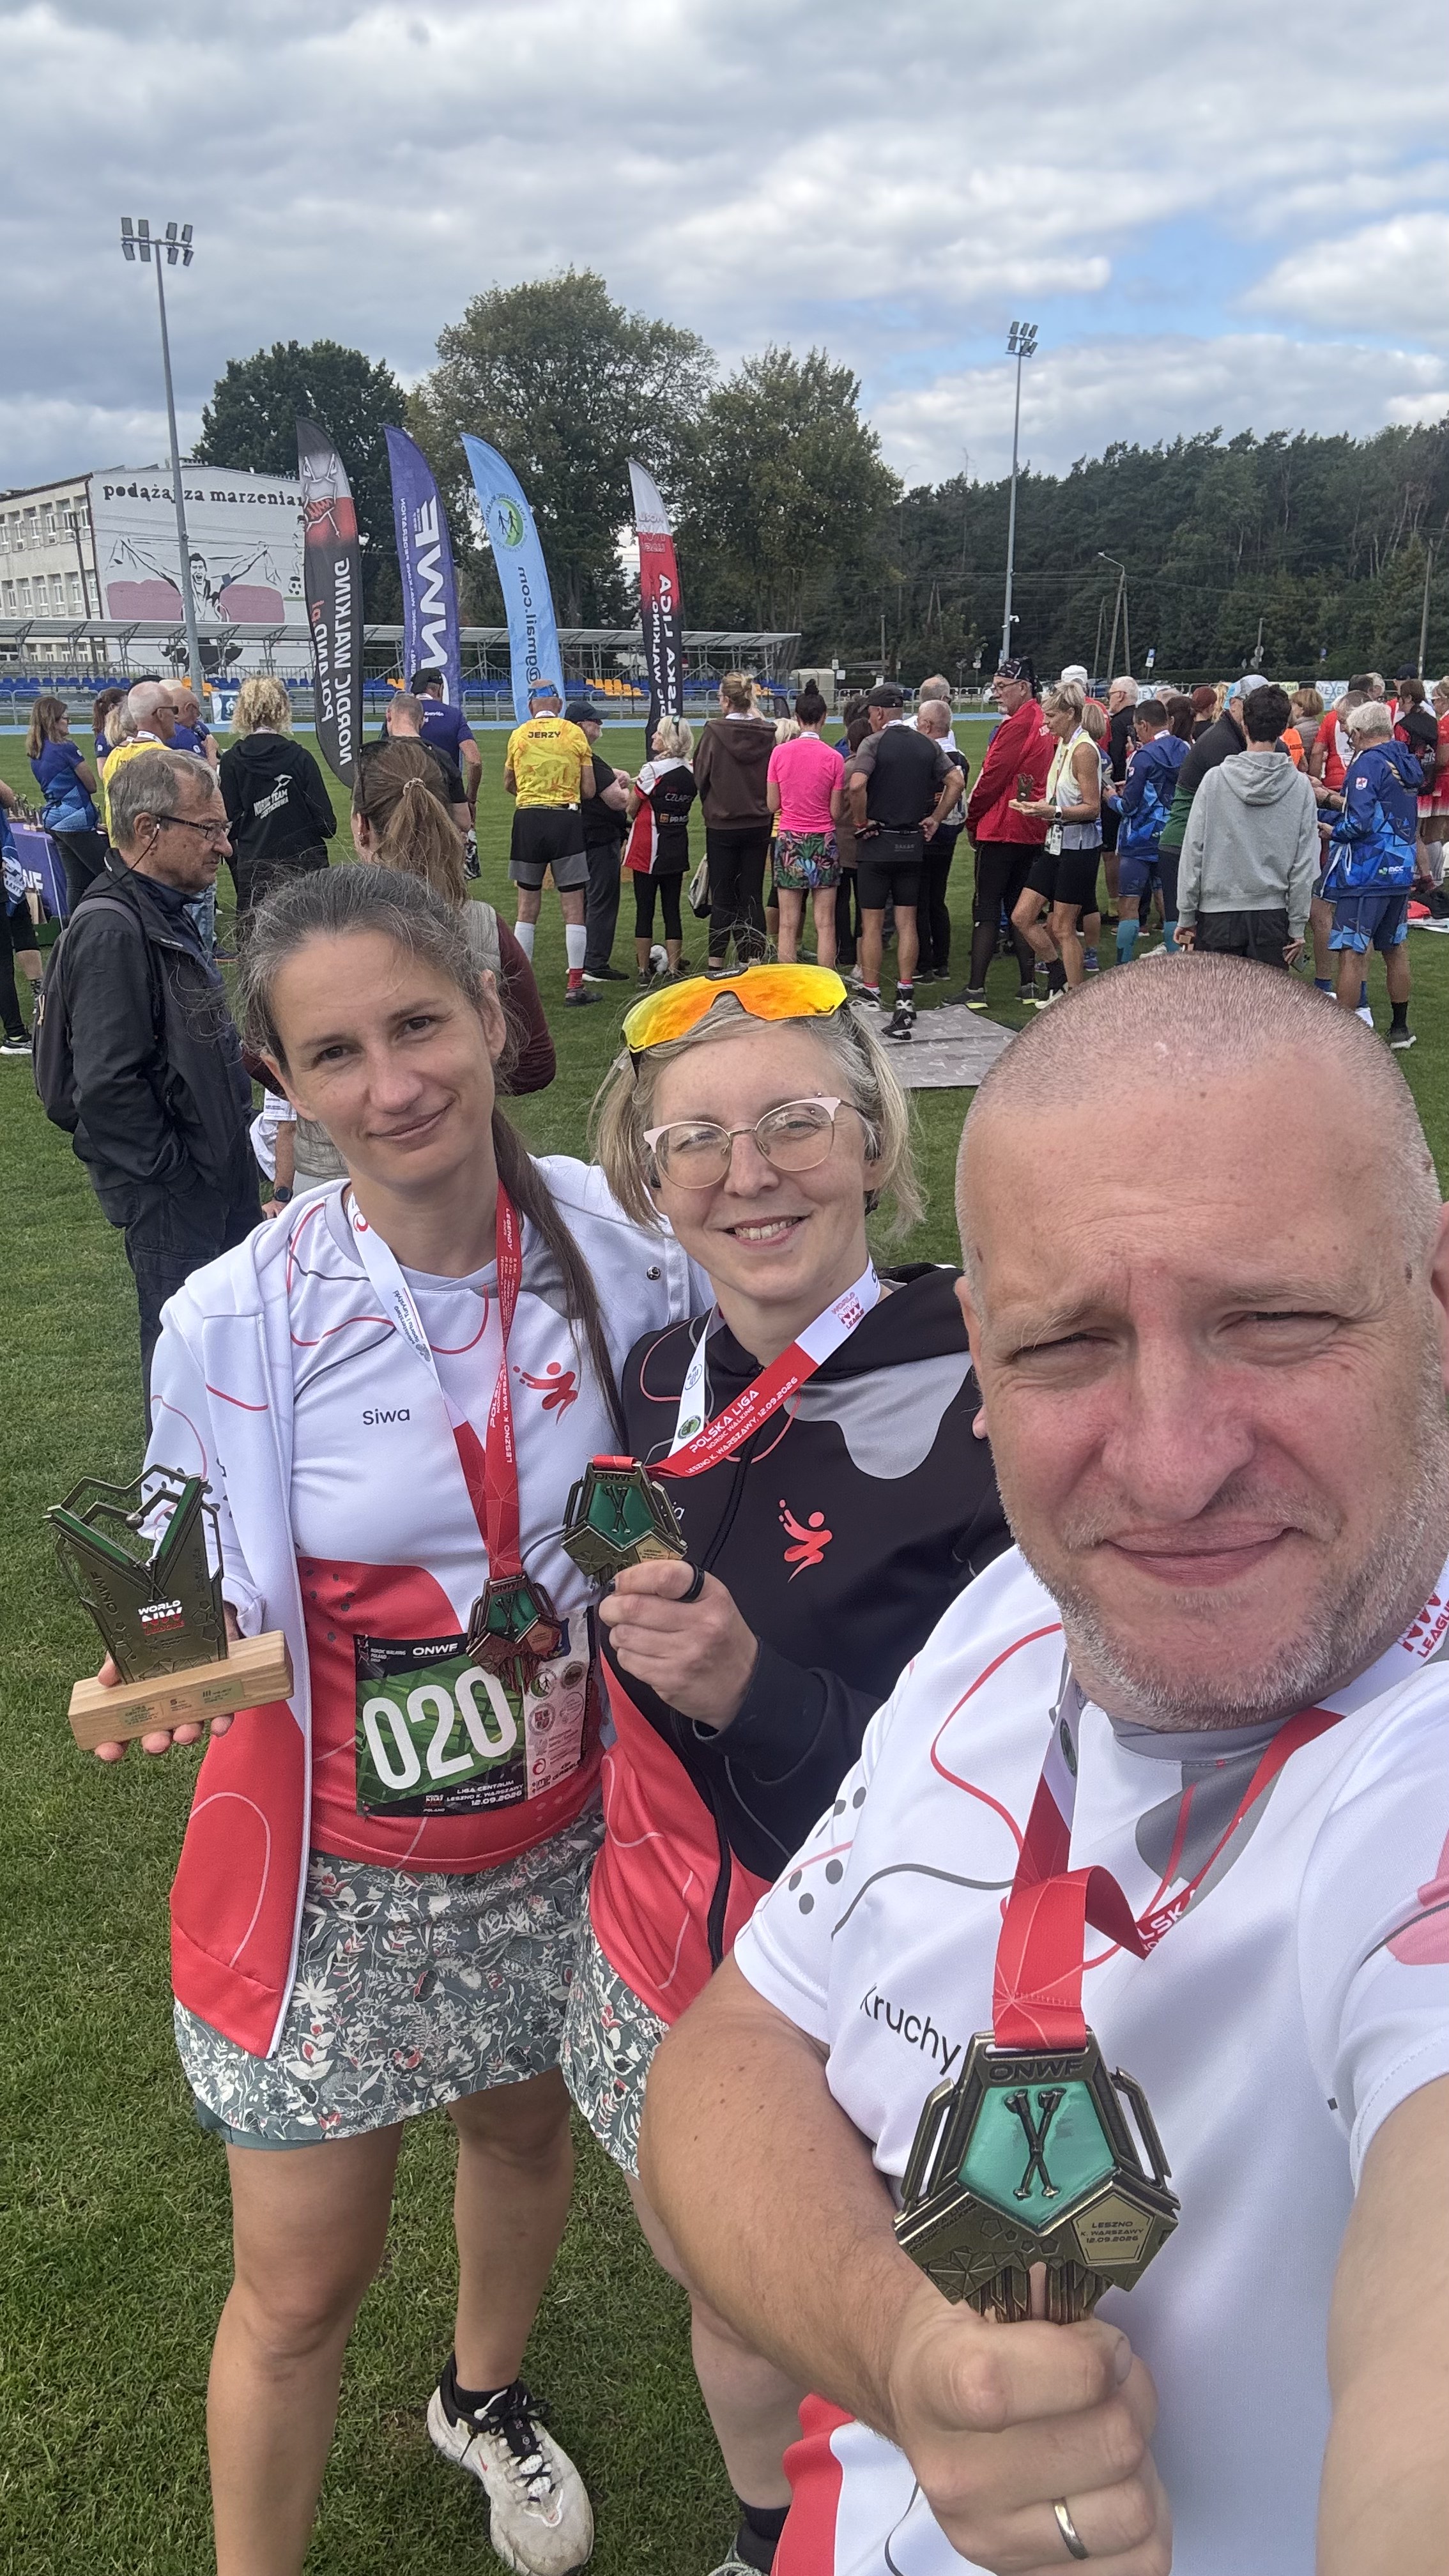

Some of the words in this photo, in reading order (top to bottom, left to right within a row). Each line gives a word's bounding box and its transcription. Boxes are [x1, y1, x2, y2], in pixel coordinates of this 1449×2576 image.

[184, 489, 204, 501] za
[271, 788, 288, 803] TEAM
[393, 1289, 410, 1317] Turystyki
[830, 1291, 855, 1314] WORLD
[393, 1305, 415, 1345] Ministerstwo
[407, 1321, 420, 1342] Sportu
[491, 1381, 500, 1427] POLSK
[362, 1408, 410, 1425] Siwa
[503, 1413, 509, 1422] K.
[685, 1457, 711, 1475] LESZNO
[716, 1415, 759, 1455] WARSZAWY,
[756, 1376, 799, 1417] 12.09.2026
[688, 1413, 733, 1454] POLSKA
[730, 1390, 760, 1416] LIGA
[706, 1430, 729, 1450] NORDIC
[726, 1404, 755, 1432] WALKING
[504, 1425, 512, 1462] LESZNO
[594, 1473, 634, 1482] ONWF
[138, 1600, 181, 1615] WORLD
[413, 1643, 458, 1656] ONWF
[363, 1666, 517, 1790] 020
[477, 1780, 514, 1791] CENTRUM
[484, 1784, 523, 1797] WARSZAWY
[1137, 1889, 1196, 1940] LSK
[990, 2059, 1084, 2082] ONWF
[908, 2228, 941, 2254] NORDIC
[940, 2202, 977, 2230] WALKING
[1089, 2227, 1144, 2236] WARSZAWY
[1092, 2220, 1133, 2228] LESZNO
